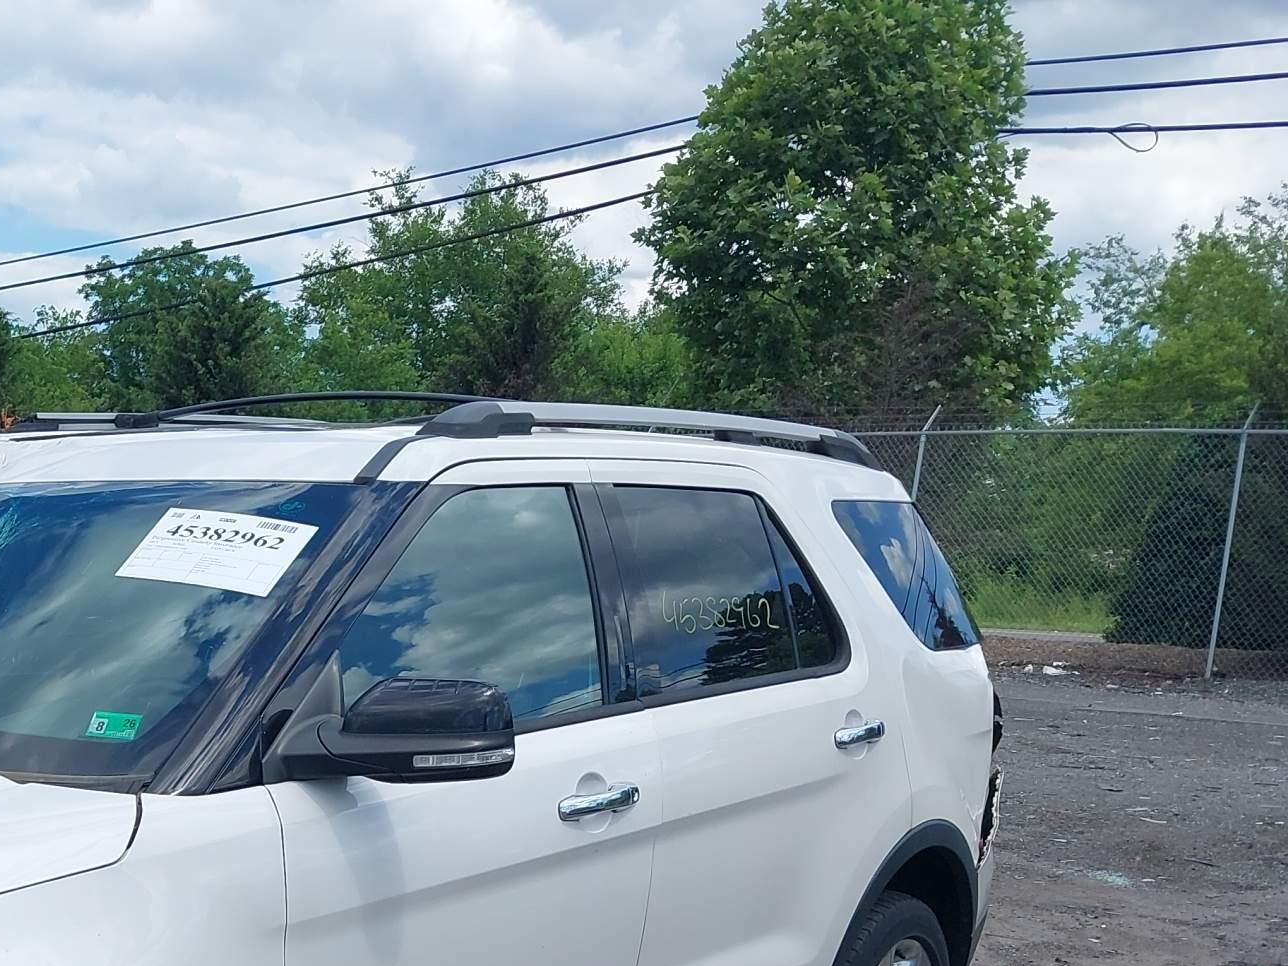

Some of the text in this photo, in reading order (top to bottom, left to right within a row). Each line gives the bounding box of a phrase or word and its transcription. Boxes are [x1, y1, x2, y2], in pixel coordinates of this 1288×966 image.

[166, 524, 285, 550] 45382962
[662, 591, 780, 634] 45382962
[95, 720, 105, 732] 8
